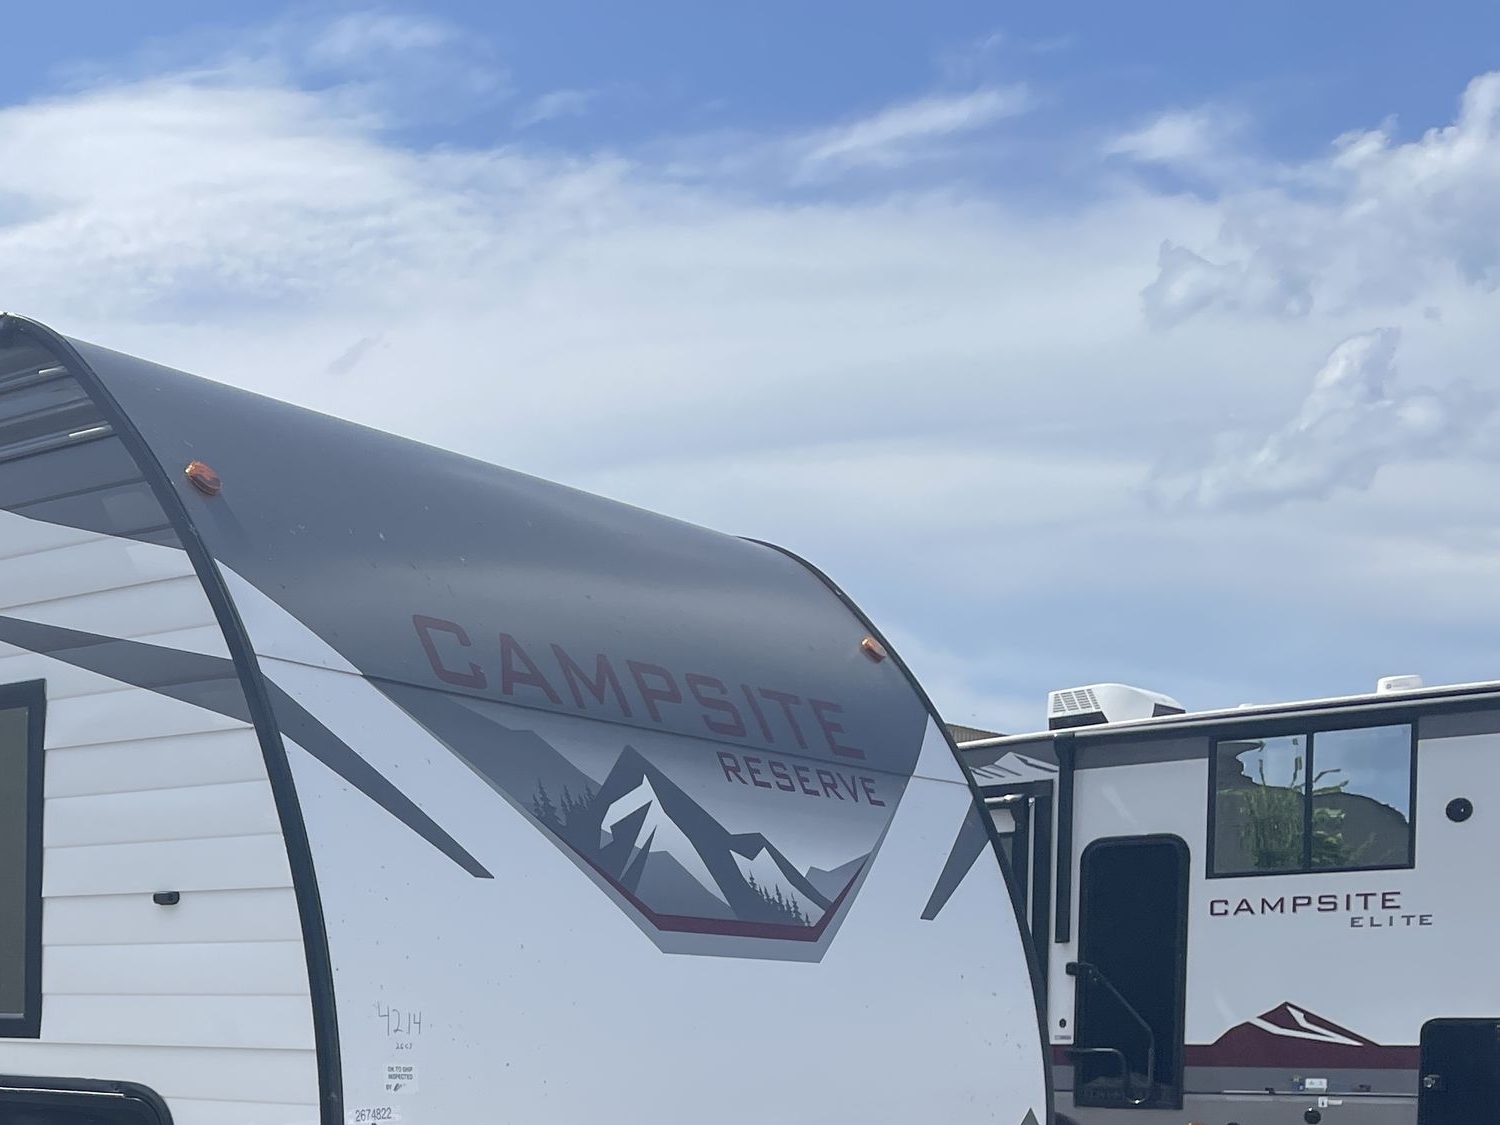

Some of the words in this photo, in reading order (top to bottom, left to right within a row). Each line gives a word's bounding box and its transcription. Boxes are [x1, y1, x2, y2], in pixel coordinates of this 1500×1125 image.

[412, 614, 867, 760] CAMPSITE
[716, 751, 887, 807] RESERVE
[1209, 891, 1401, 917] CAMPSITE
[1350, 914, 1433, 928] ELITE
[377, 1001, 422, 1036] 4214
[355, 1107, 392, 1122] 2674822
